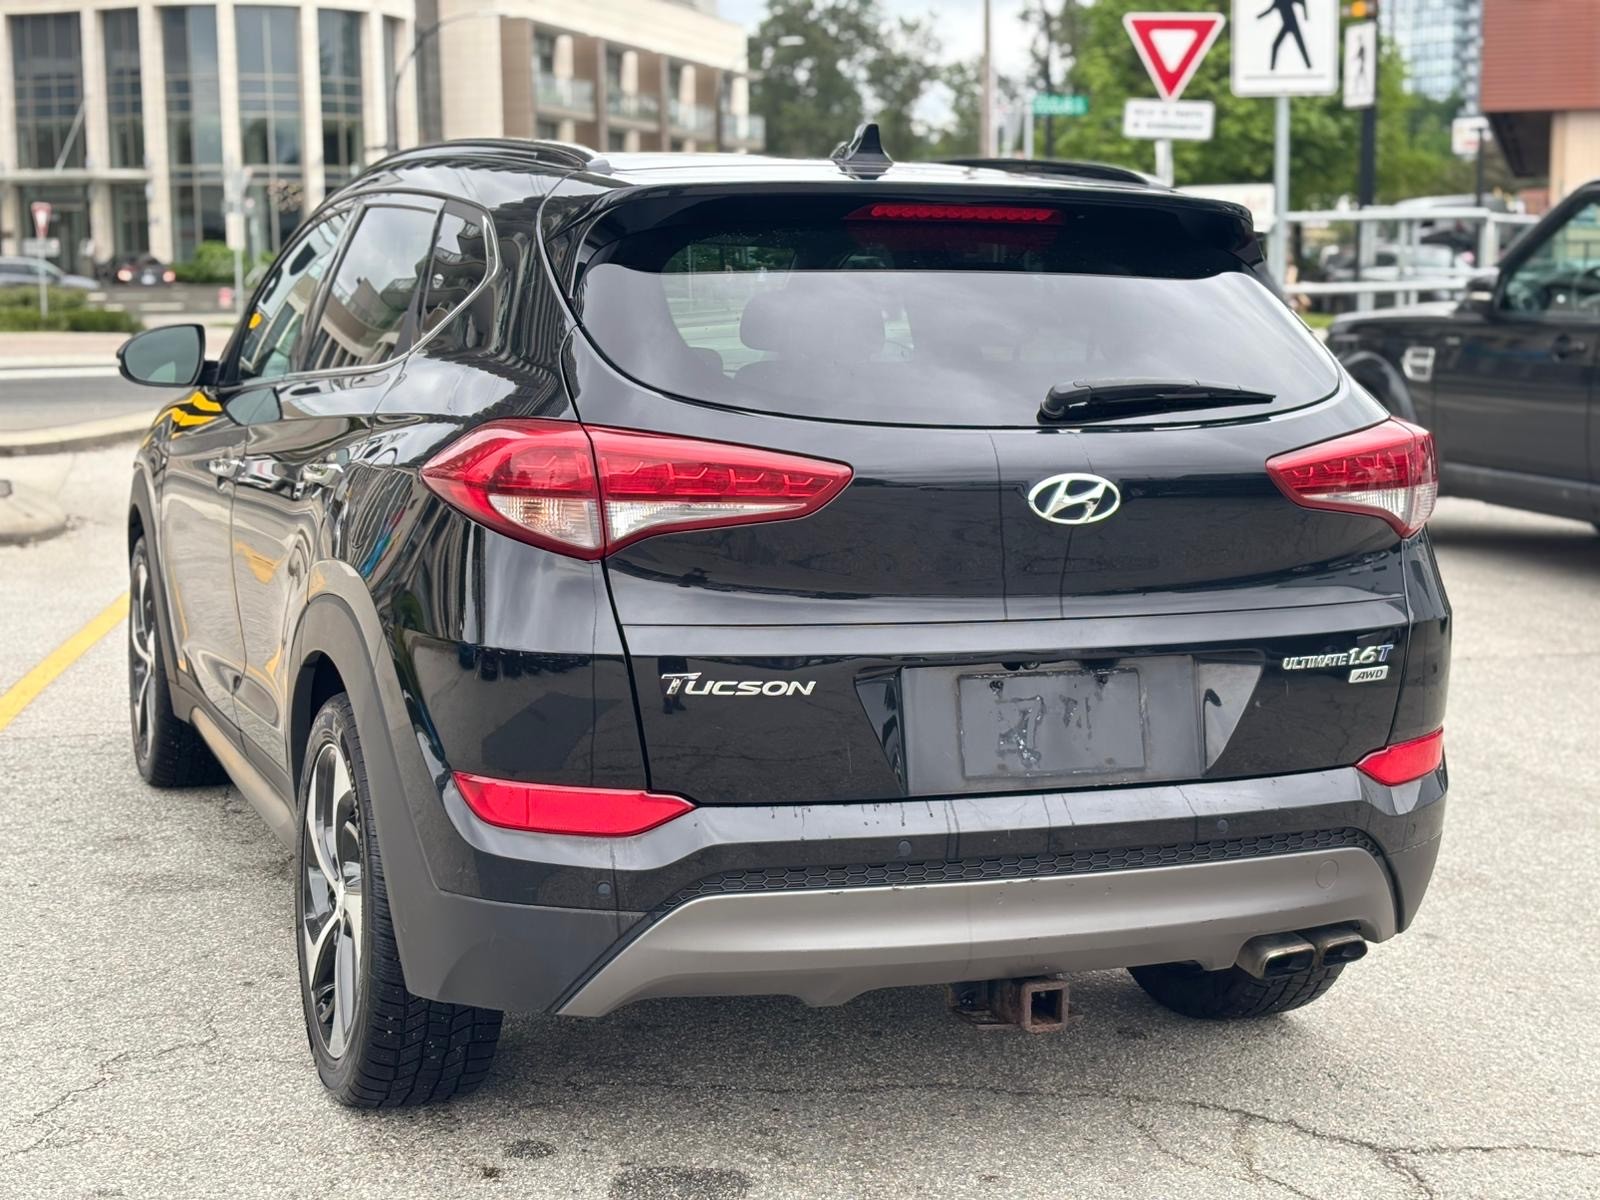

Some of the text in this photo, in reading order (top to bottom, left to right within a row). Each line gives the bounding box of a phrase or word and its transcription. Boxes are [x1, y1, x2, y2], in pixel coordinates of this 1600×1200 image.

[1282, 653, 1348, 670] ULTIMATE
[1354, 669, 1384, 681] AWD
[661, 672, 817, 696] TUCSON
